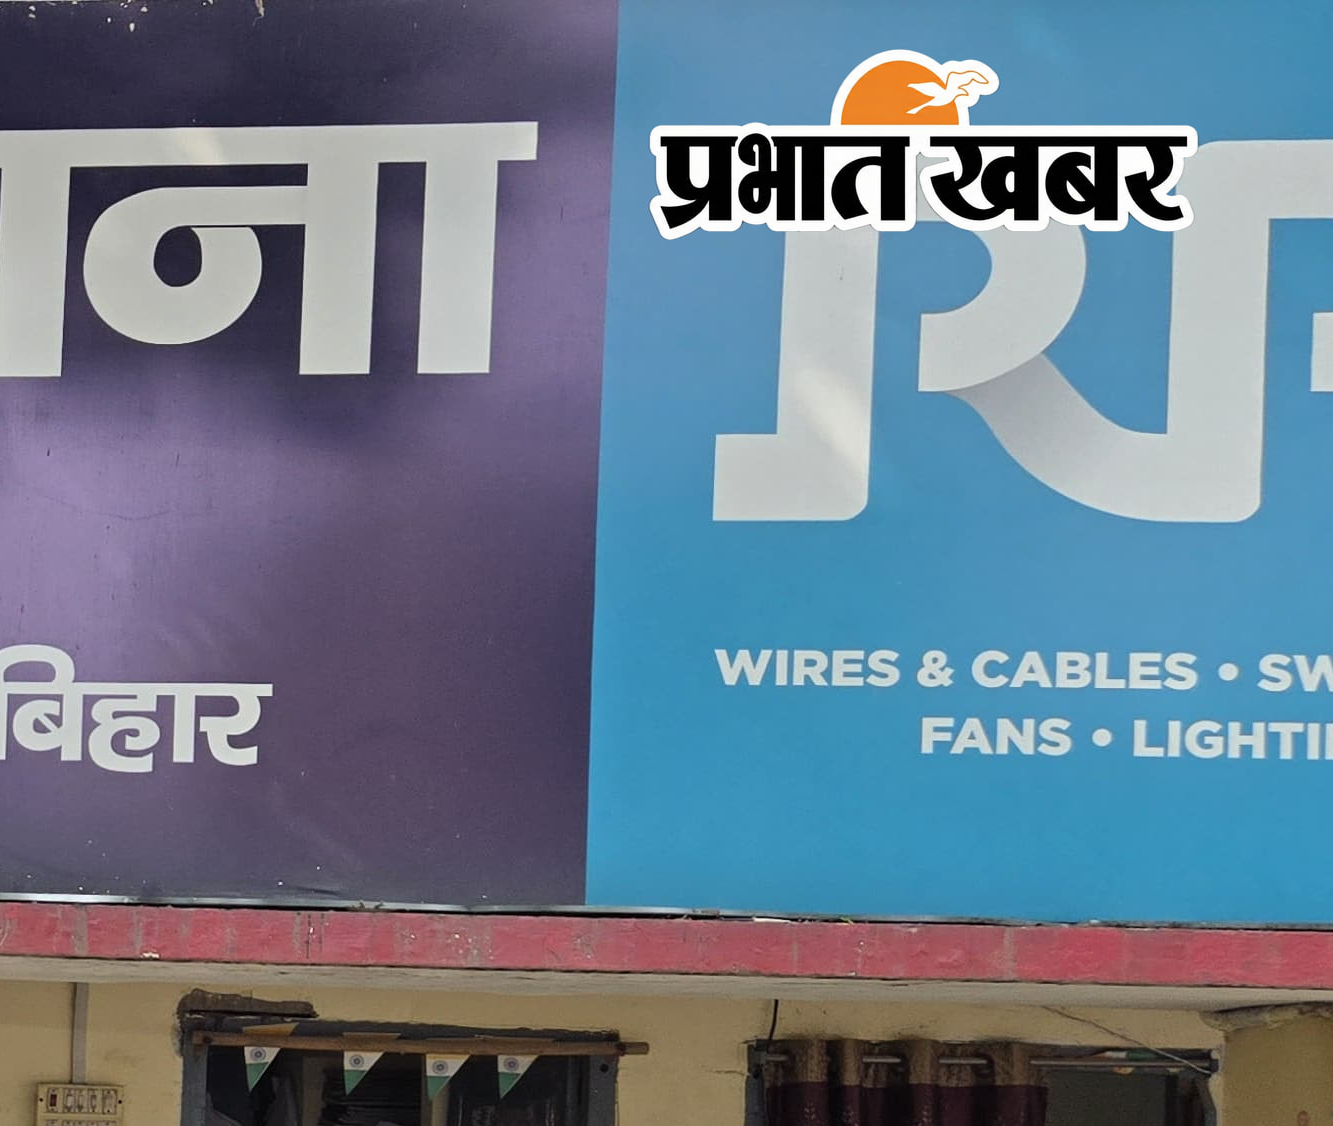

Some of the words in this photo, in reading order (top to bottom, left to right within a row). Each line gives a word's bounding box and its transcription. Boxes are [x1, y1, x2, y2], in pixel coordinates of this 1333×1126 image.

[714, 648, 902, 688] WIRES
[916, 649, 955, 689] &
[971, 649, 1200, 691] CABLES
[920, 716, 1074, 757] FANS
